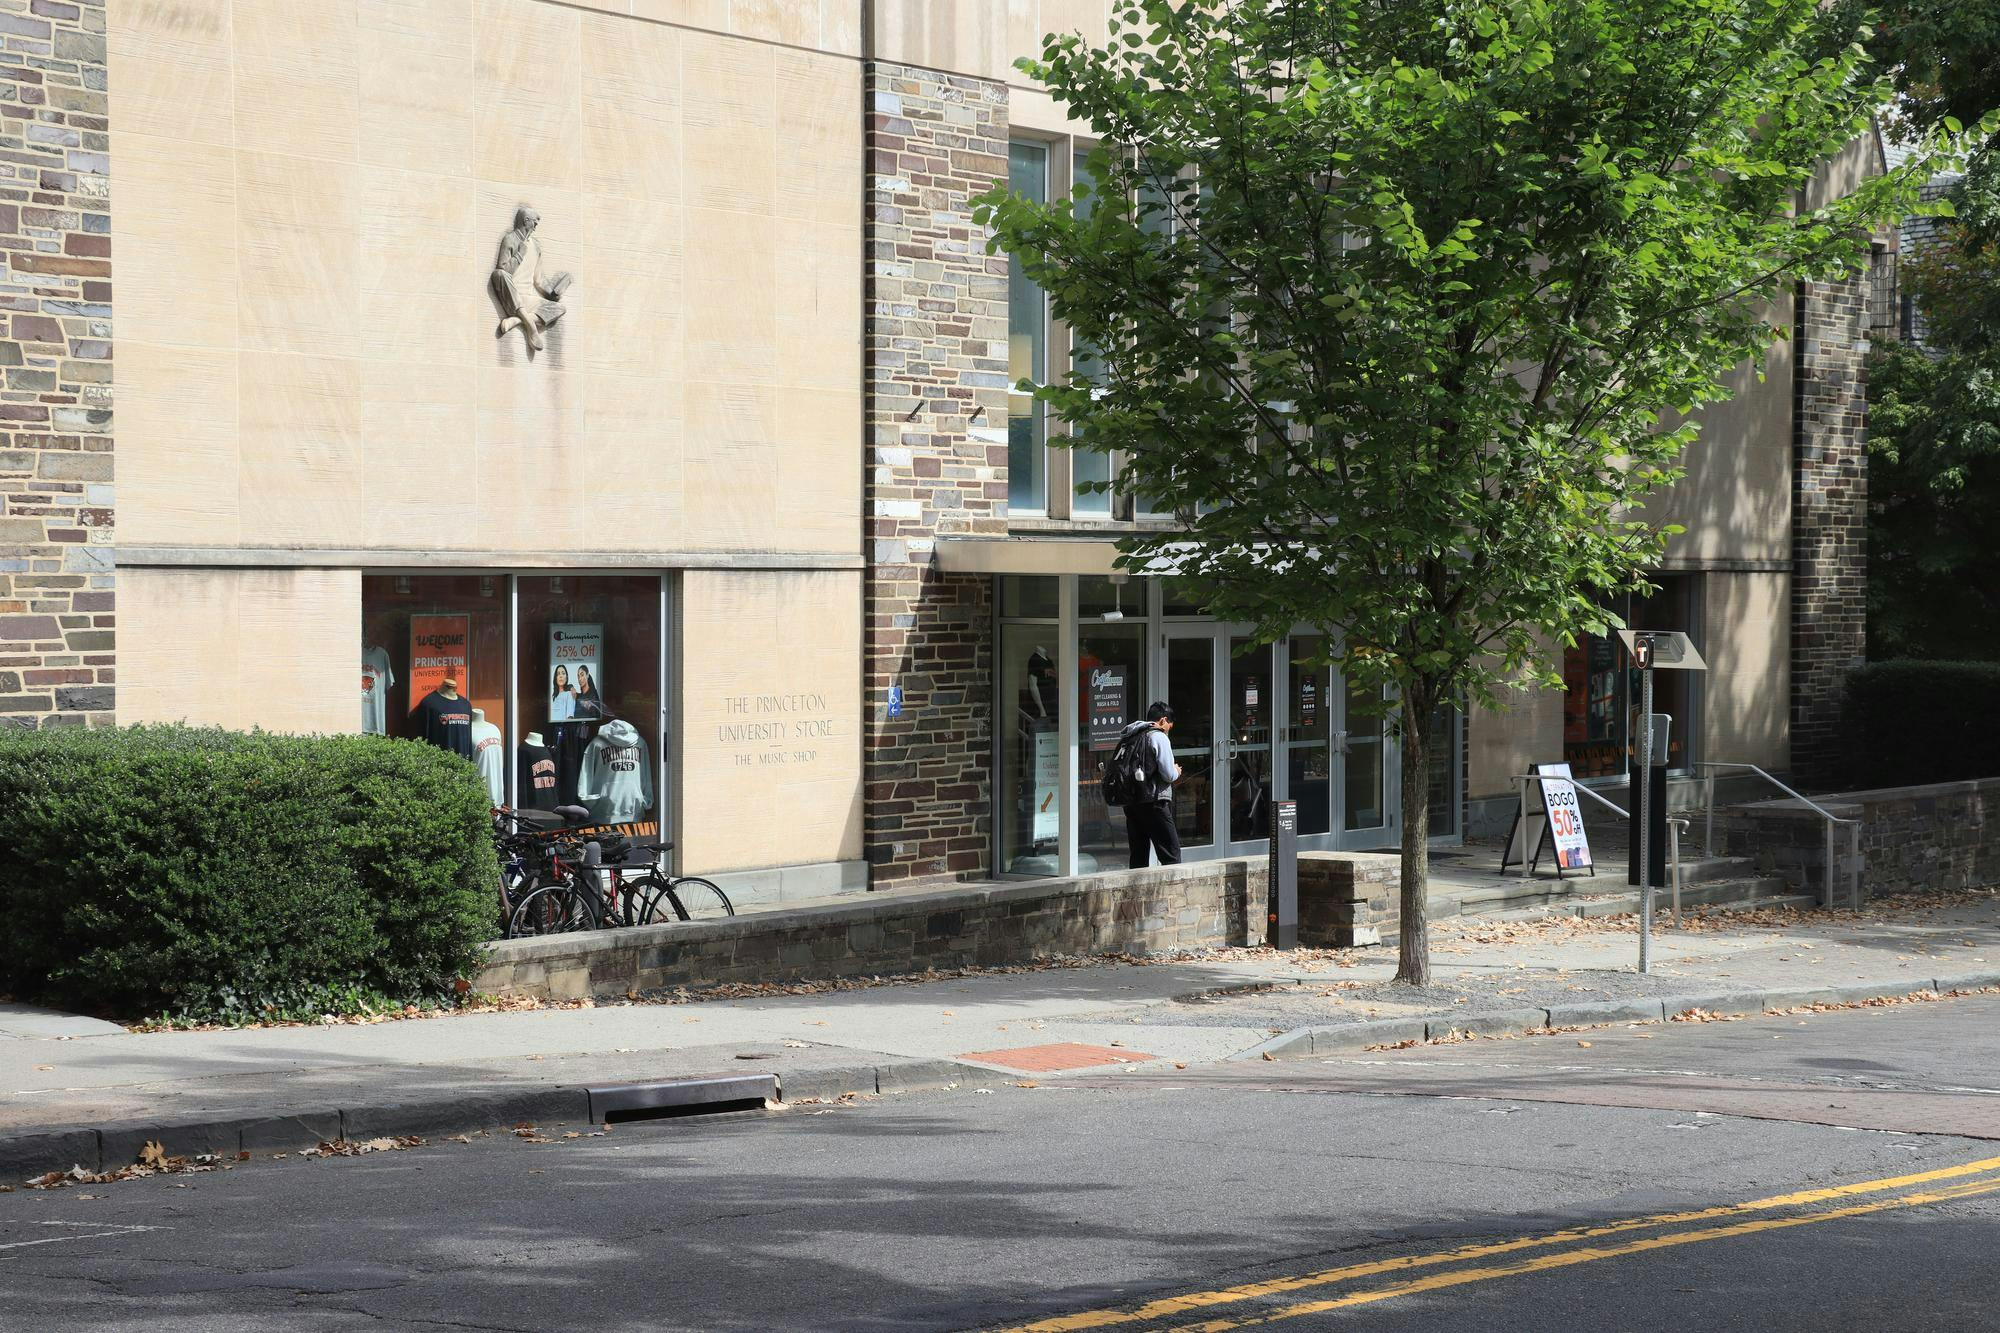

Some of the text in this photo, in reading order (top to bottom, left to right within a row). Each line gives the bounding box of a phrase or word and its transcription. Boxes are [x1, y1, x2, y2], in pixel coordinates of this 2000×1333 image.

[416, 634, 465, 649] WELCOME
[554, 631, 600, 643] Champion
[556, 644, 595, 657] 25% Off
[415, 656, 465, 668] PRINCETON
[414, 669, 447, 678] UNIVERSITY
[725, 694, 826, 714] THE PRINCETON
[719, 720, 833, 742] UNIVERSITY STORE
[735, 750, 817, 766] THE MUSIC SHOP
[1548, 791, 1575, 807] BOGO
[1574, 823, 1582, 834] off
